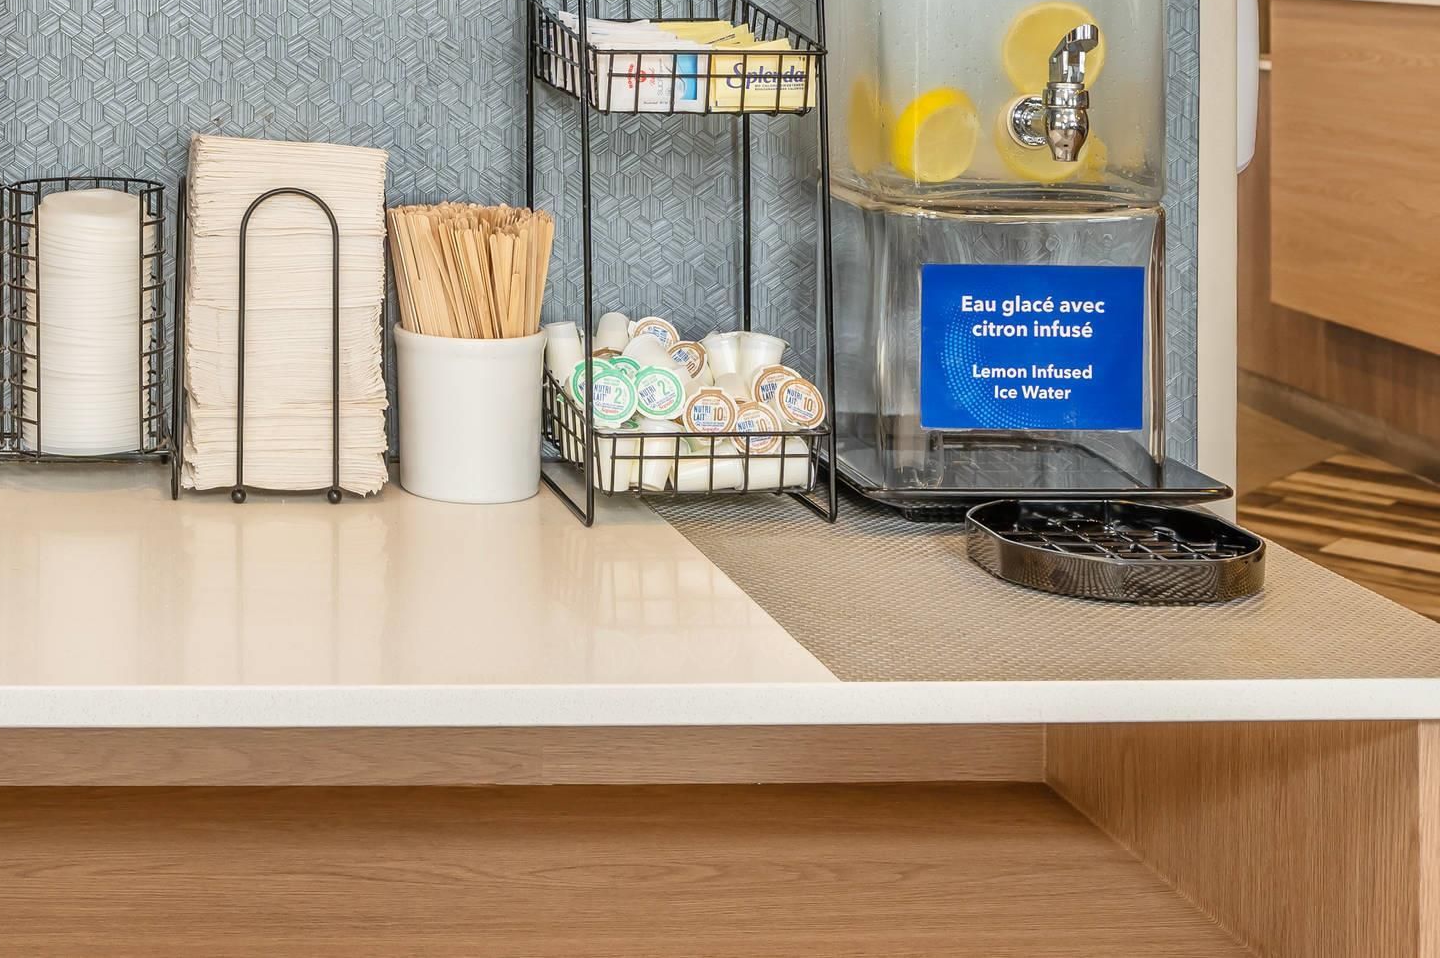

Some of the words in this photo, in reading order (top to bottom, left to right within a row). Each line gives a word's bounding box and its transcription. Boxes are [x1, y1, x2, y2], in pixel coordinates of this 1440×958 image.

[726, 62, 804, 89] Splenda
[961, 296, 996, 312] Eau
[1002, 296, 1054, 318] glacé
[1059, 300, 1104, 314] avec
[972, 320, 1028, 338] citron
[1034, 320, 1093, 338] infusé
[972, 365, 1027, 380] Lemon
[1032, 365, 1092, 380] Infused
[994, 386, 1018, 400] Ice
[1021, 386, 1072, 400] Water
[713, 407, 724, 421] 10
